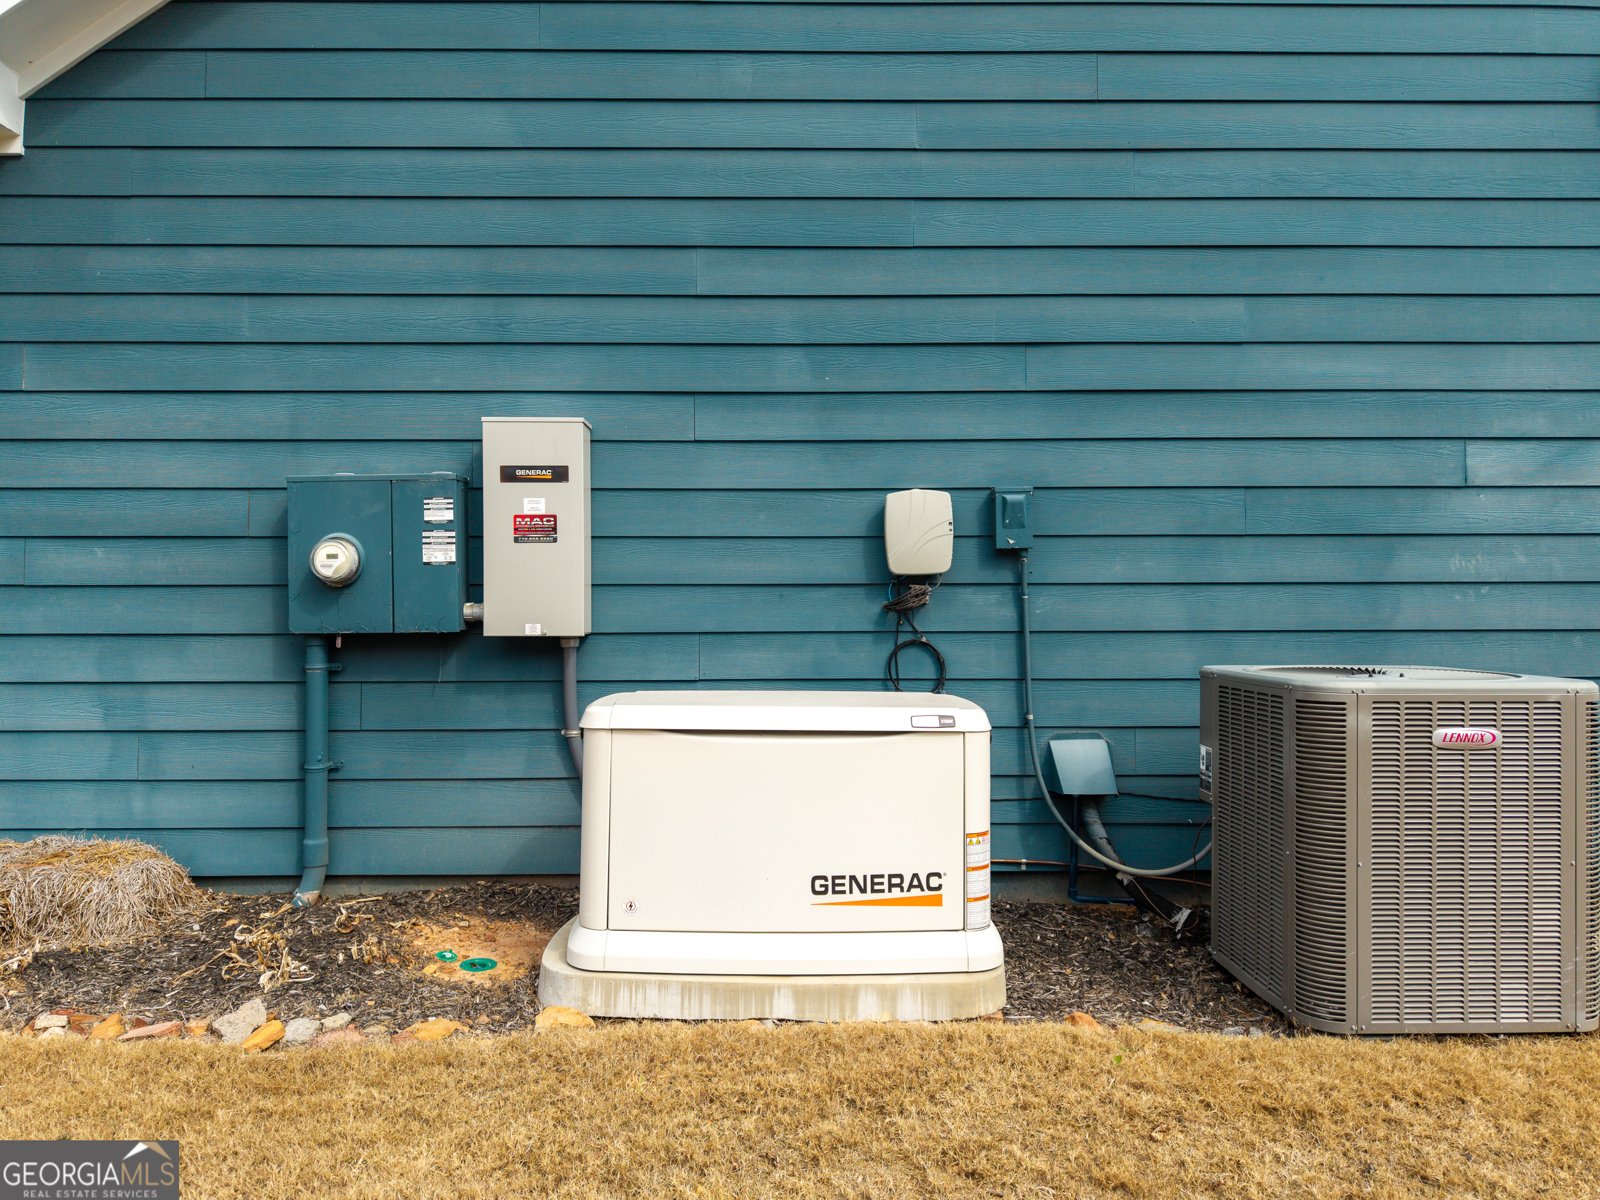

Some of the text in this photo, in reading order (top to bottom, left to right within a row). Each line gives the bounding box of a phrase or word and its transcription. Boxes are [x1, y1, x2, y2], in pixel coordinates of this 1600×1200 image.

[515, 517, 555, 525] MAC
[1442, 732, 1487, 743] LENNOX
[810, 871, 943, 896] GENERAC
